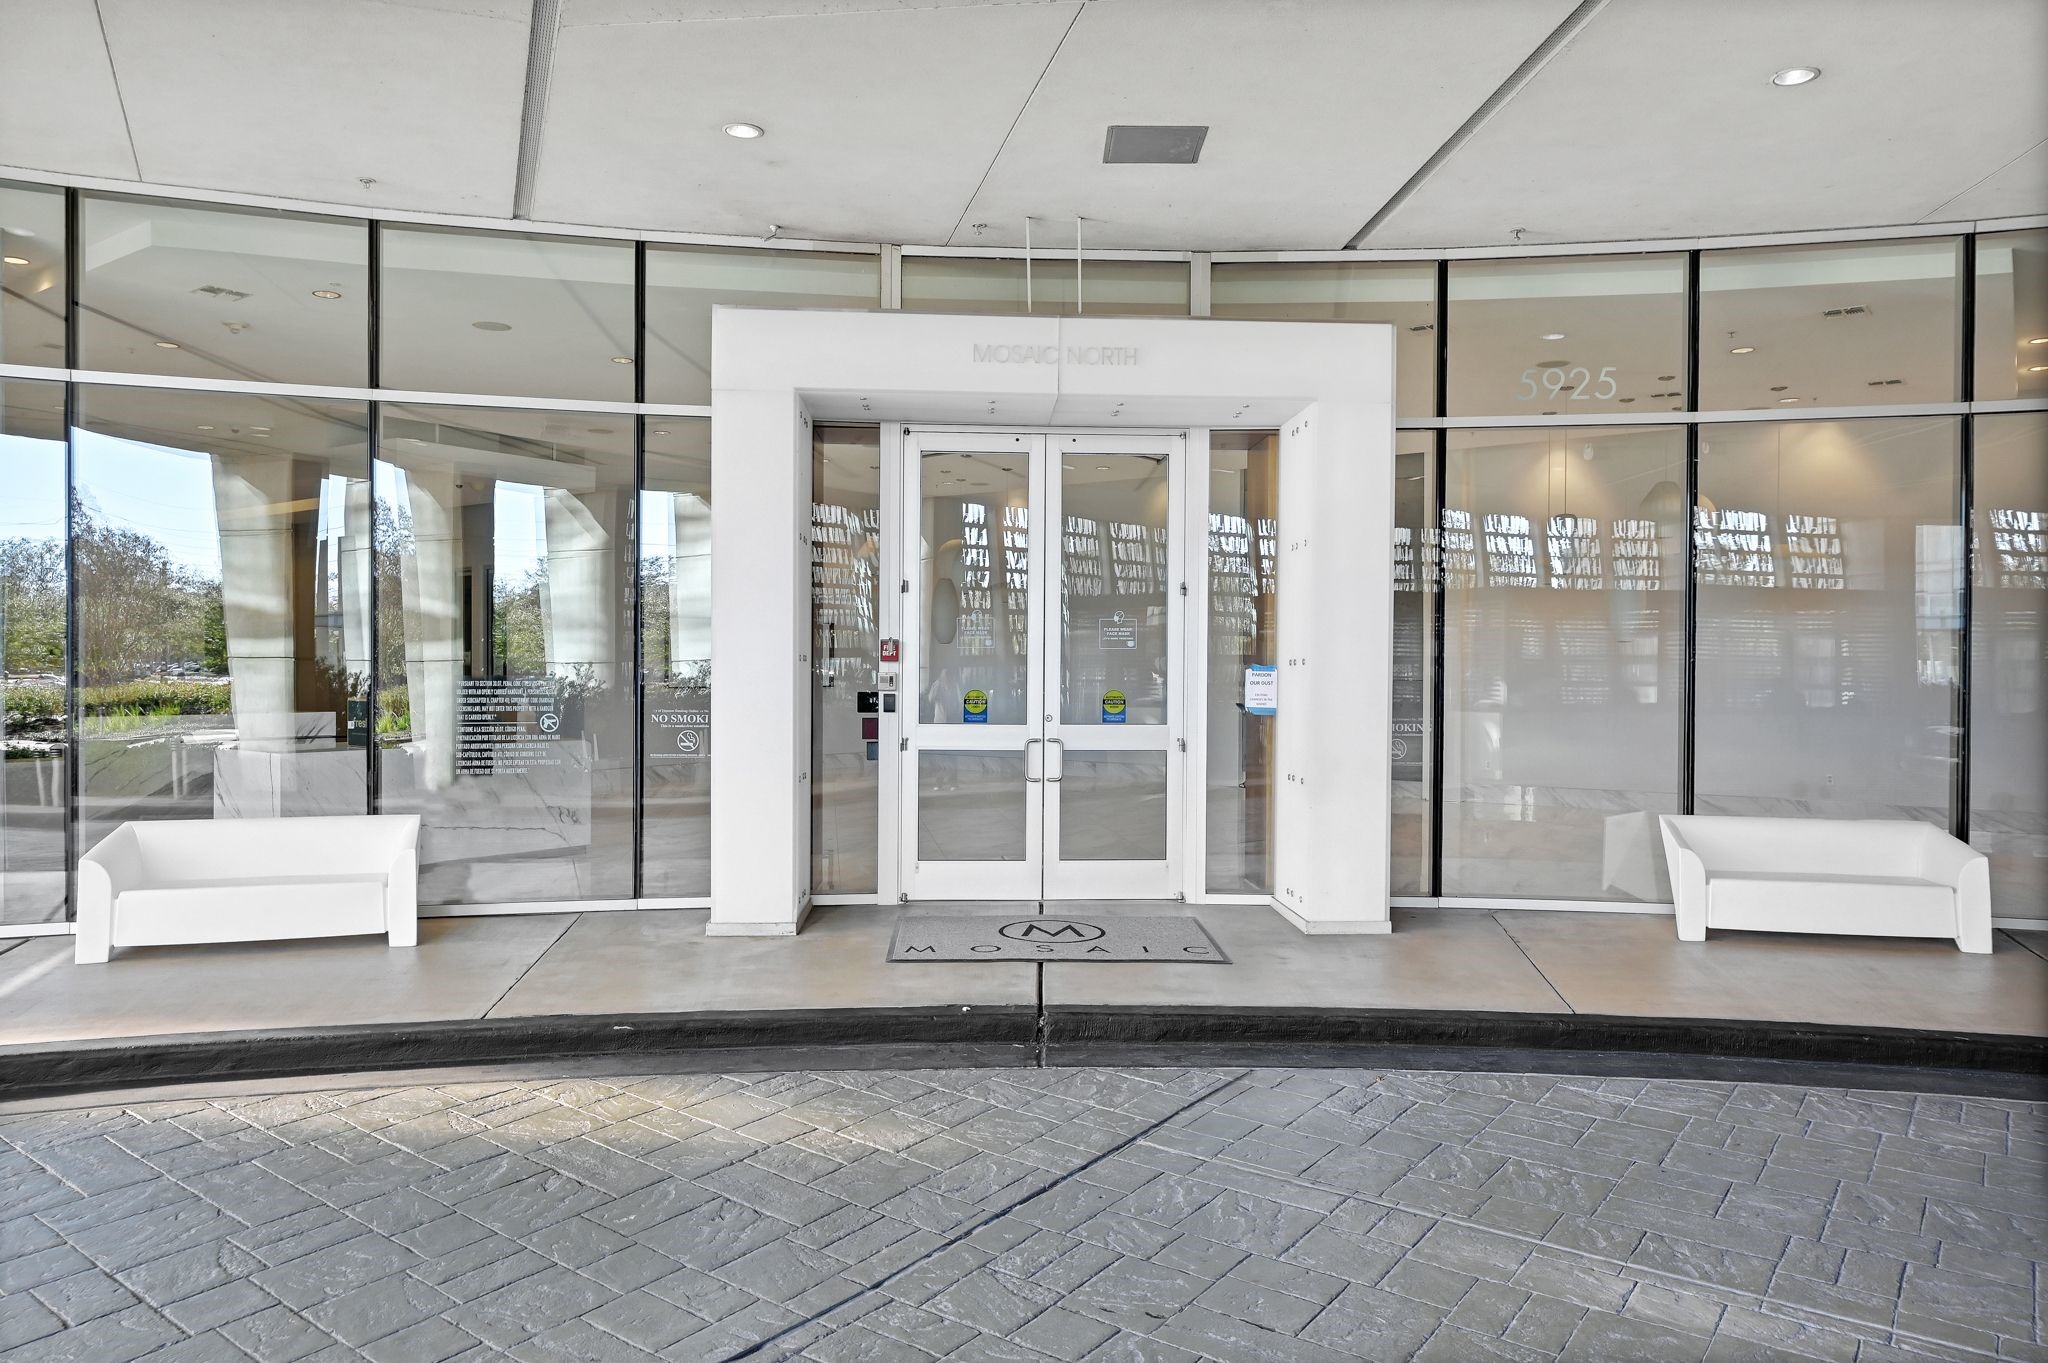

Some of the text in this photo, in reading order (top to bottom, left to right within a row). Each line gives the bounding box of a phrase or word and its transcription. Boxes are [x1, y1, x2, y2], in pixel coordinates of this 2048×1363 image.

[973, 343, 1137, 366] MOSAIC NORTH
[1517, 366, 1617, 400] 5925
[651, 714, 708, 723] NO SMOKI
[1021, 924, 1085, 938] M
[905, 944, 1209, 954] MOSAIC
